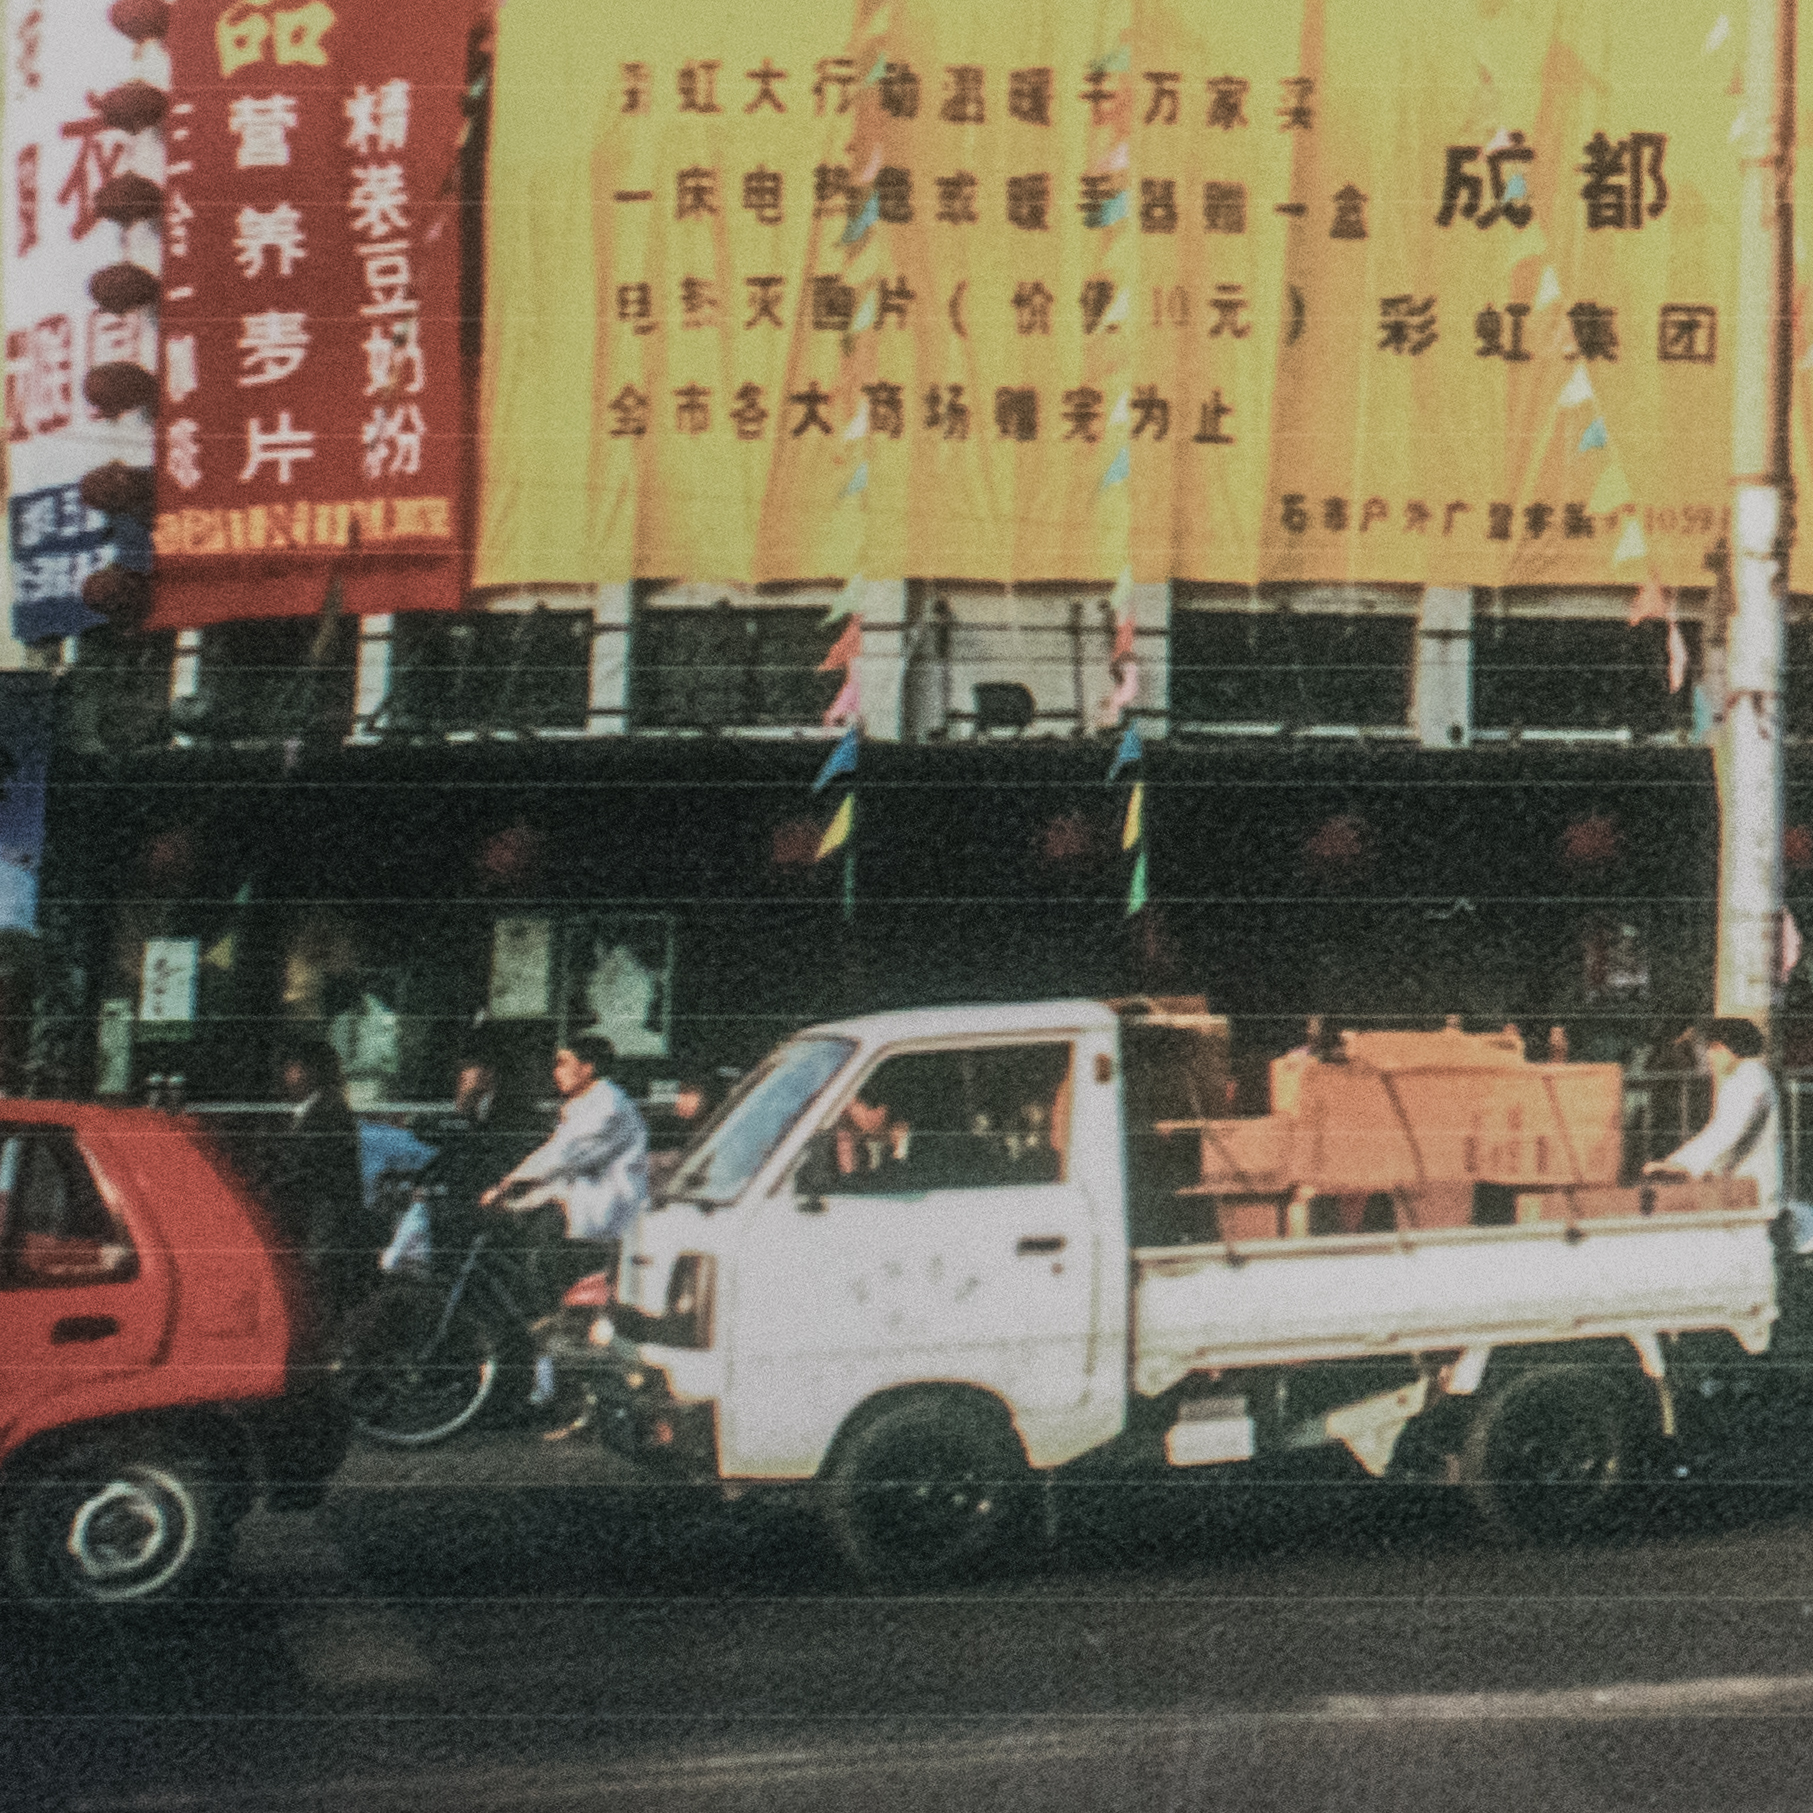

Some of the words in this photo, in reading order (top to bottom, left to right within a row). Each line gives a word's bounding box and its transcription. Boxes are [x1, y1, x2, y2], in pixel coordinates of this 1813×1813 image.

[228, 94, 315, 483] 营养麦片
[345, 79, 426, 478] 精装豆奶粉
[1436, 131, 1668, 230] 成都
[1377, 292, 1717, 366] 彩虹集团
